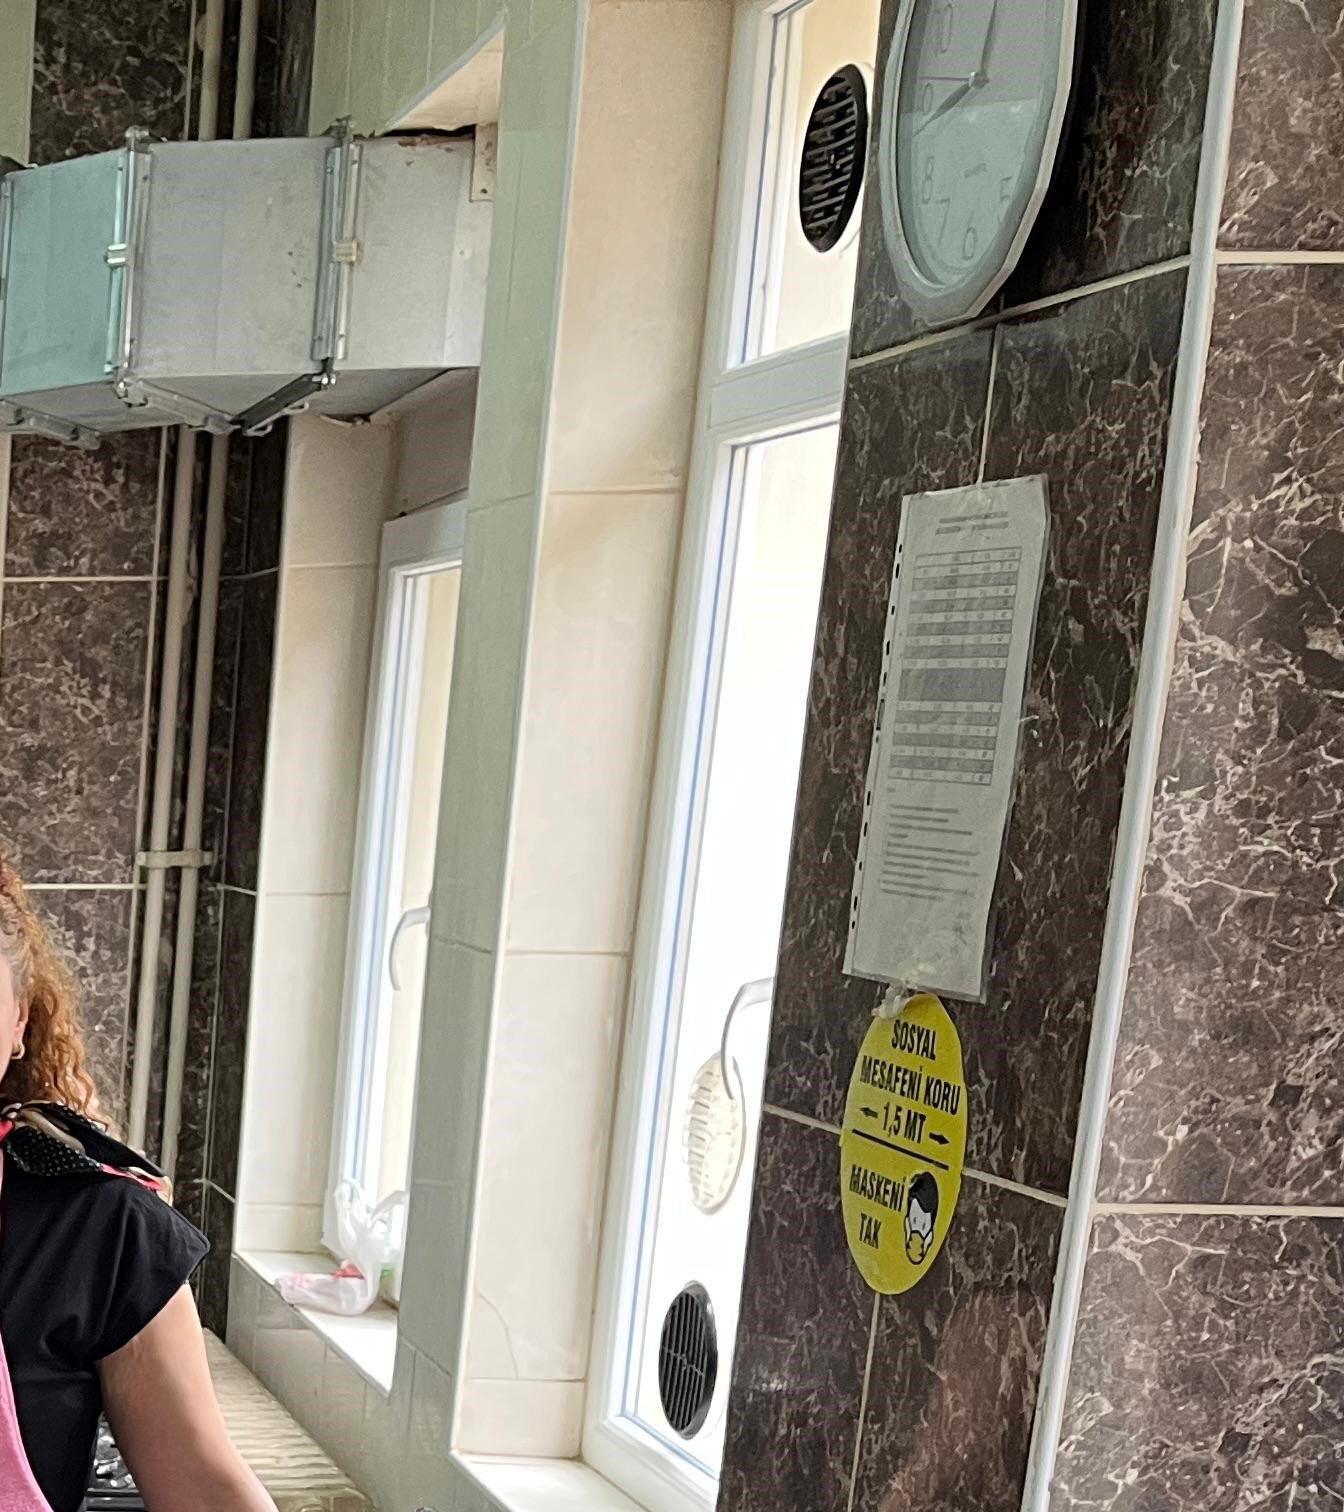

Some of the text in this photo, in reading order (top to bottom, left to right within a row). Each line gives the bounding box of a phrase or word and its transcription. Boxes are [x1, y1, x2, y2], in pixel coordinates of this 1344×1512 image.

[891, 1018, 937, 1061] SOSYAL
[859, 1054, 962, 1116] MESAFENİ KORU
[883, 1101, 927, 1144] 1,5 MT
[849, 1163, 907, 1213] MASKENİ
[859, 1212, 883, 1250] TAK
